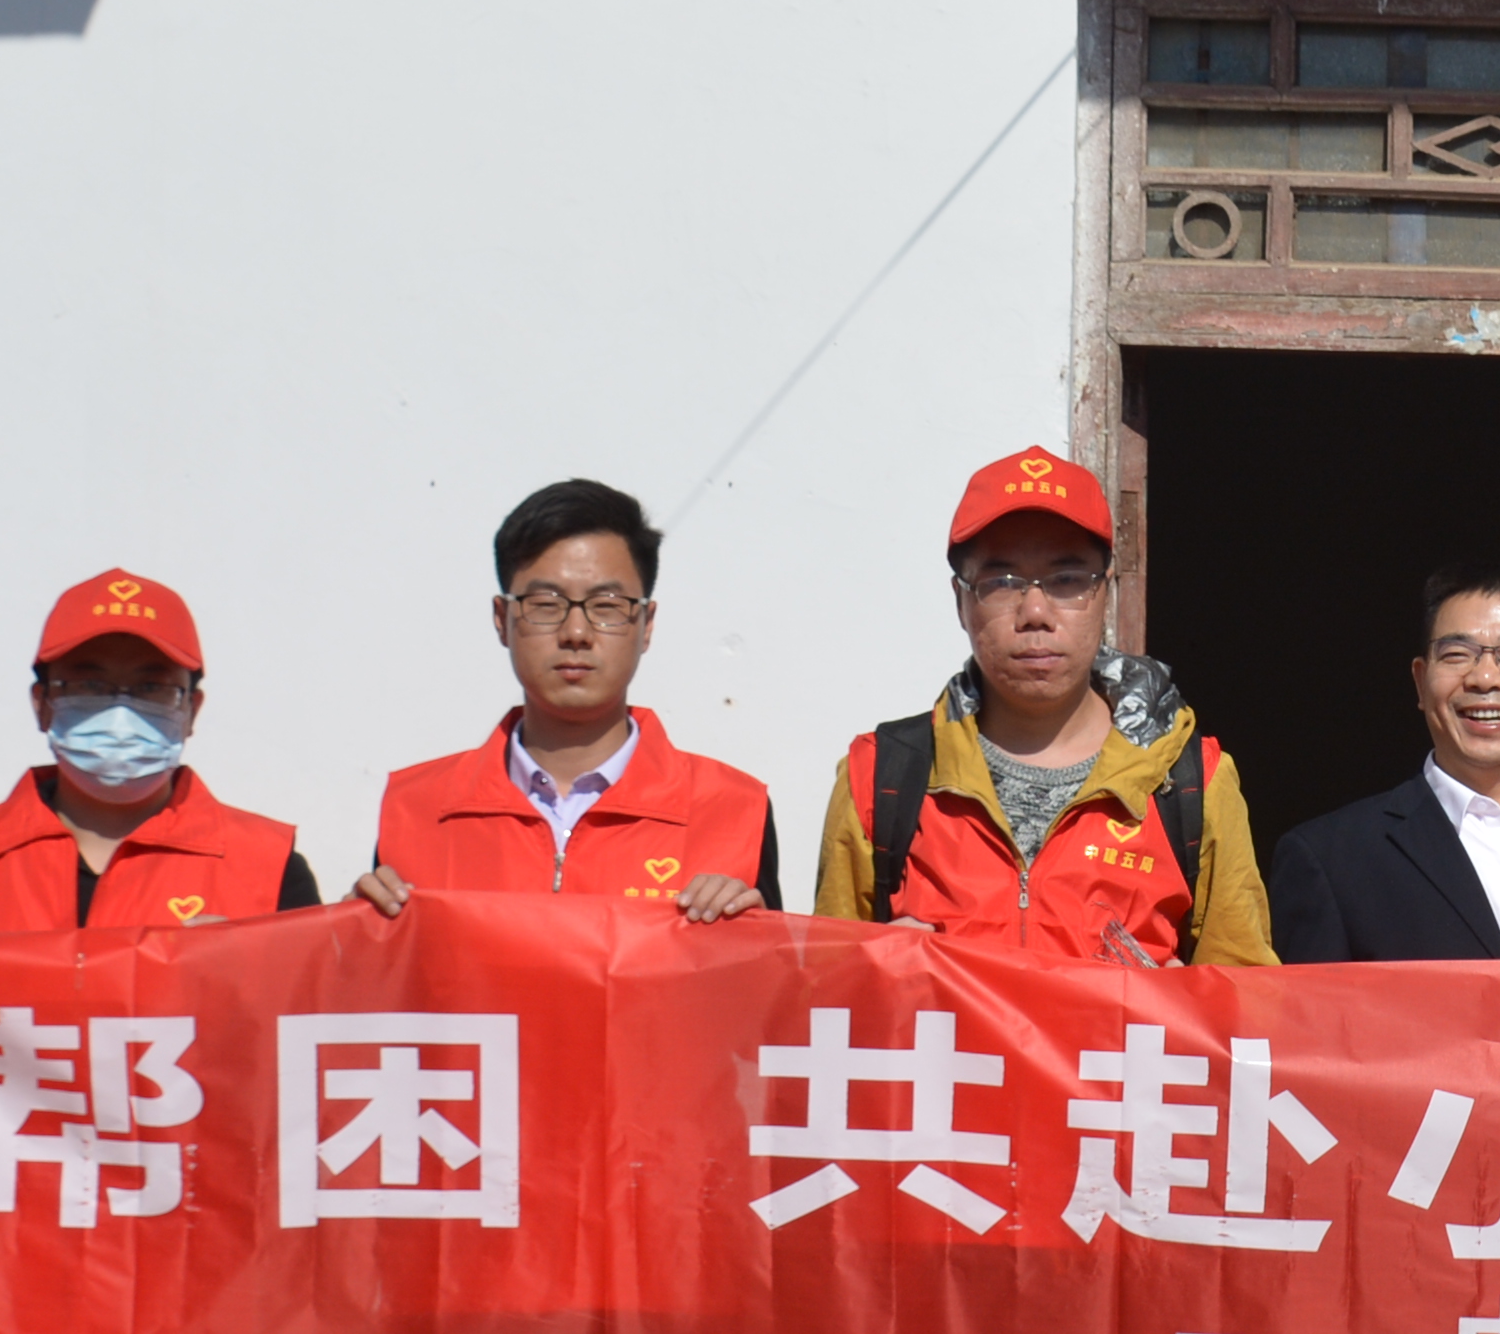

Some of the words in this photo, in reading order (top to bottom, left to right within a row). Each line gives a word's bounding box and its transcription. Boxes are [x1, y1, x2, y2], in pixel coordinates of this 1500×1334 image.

[1004, 481, 1069, 499] 中建五局
[1083, 843, 1156, 874] 中建五局
